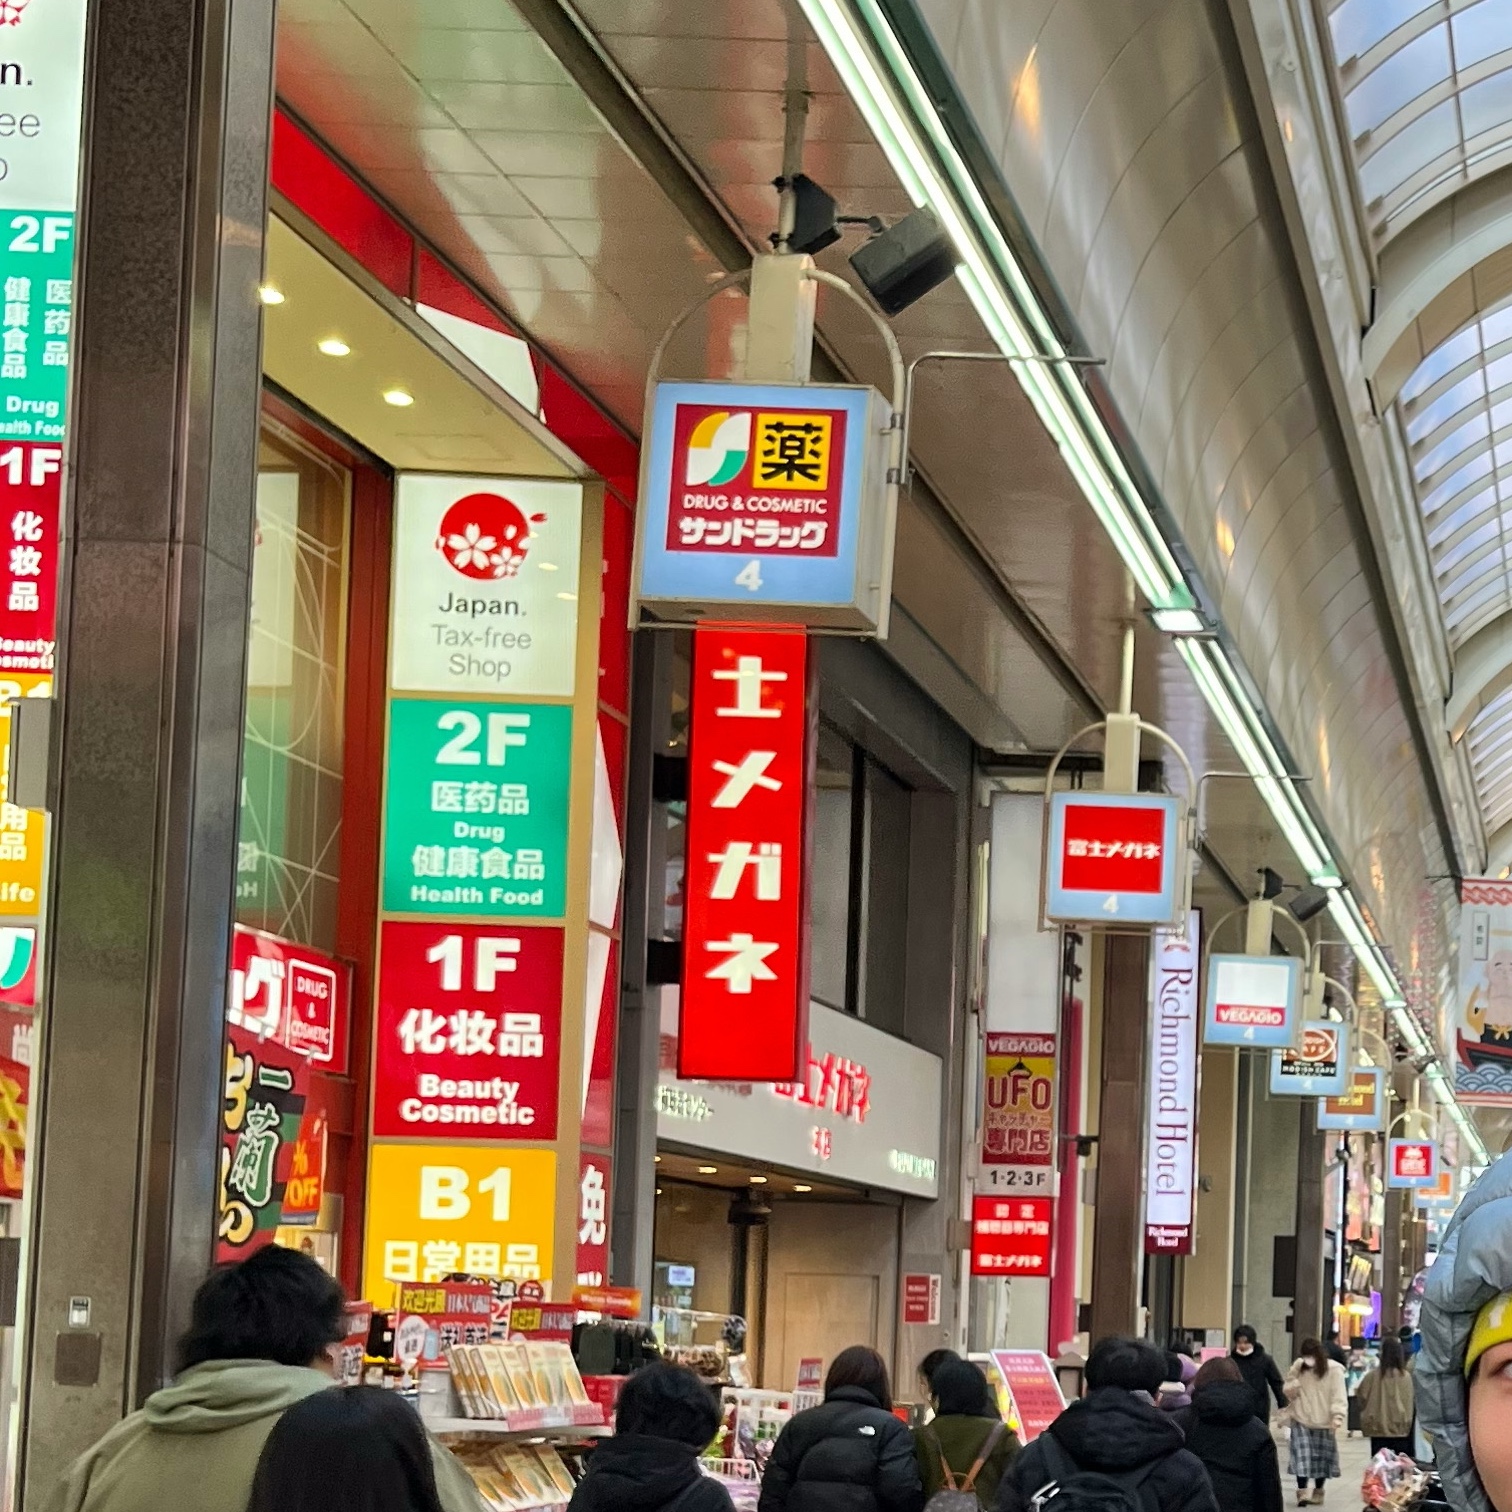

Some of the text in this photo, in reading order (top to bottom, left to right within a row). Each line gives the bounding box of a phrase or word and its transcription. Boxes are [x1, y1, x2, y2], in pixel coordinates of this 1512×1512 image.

[8, 215, 73, 253] 2F
[6, 395, 60, 418] Drug
[0, 447, 62, 486] 1F
[761, 421, 823, 481] 薬
[683, 494, 828, 514] DRUG & COSMETIC
[679, 516, 828, 549] サンドラッグ
[8, 511, 43, 612] 化妆品
[735, 560, 763, 591] 4
[439, 592, 527, 618] Japan.
[431, 624, 532, 650] Tax-free
[448, 653, 512, 682] Shop
[435, 710, 531, 766] 2F
[431, 780, 530, 815] 医药品
[454, 821, 505, 843] Drug
[702, 655, 788, 994] 士メガネ
[412, 845, 545, 881] 健康食品
[1067, 839, 1161, 859] 富士メガネ
[411, 885, 544, 906] Health Food
[1103, 894, 1119, 913] 4
[426, 935, 521, 992] 1F
[296, 975, 329, 999] DRUG
[398, 1008, 544, 1058] 化妆品
[417, 1073, 519, 1101] Beauty
[987, 1075, 1051, 1111] UFO
[1156, 966, 1194, 1196] Richmond Hotel
[400, 1099, 534, 1125] Cosmetic
[419, 1165, 512, 1222] B1
